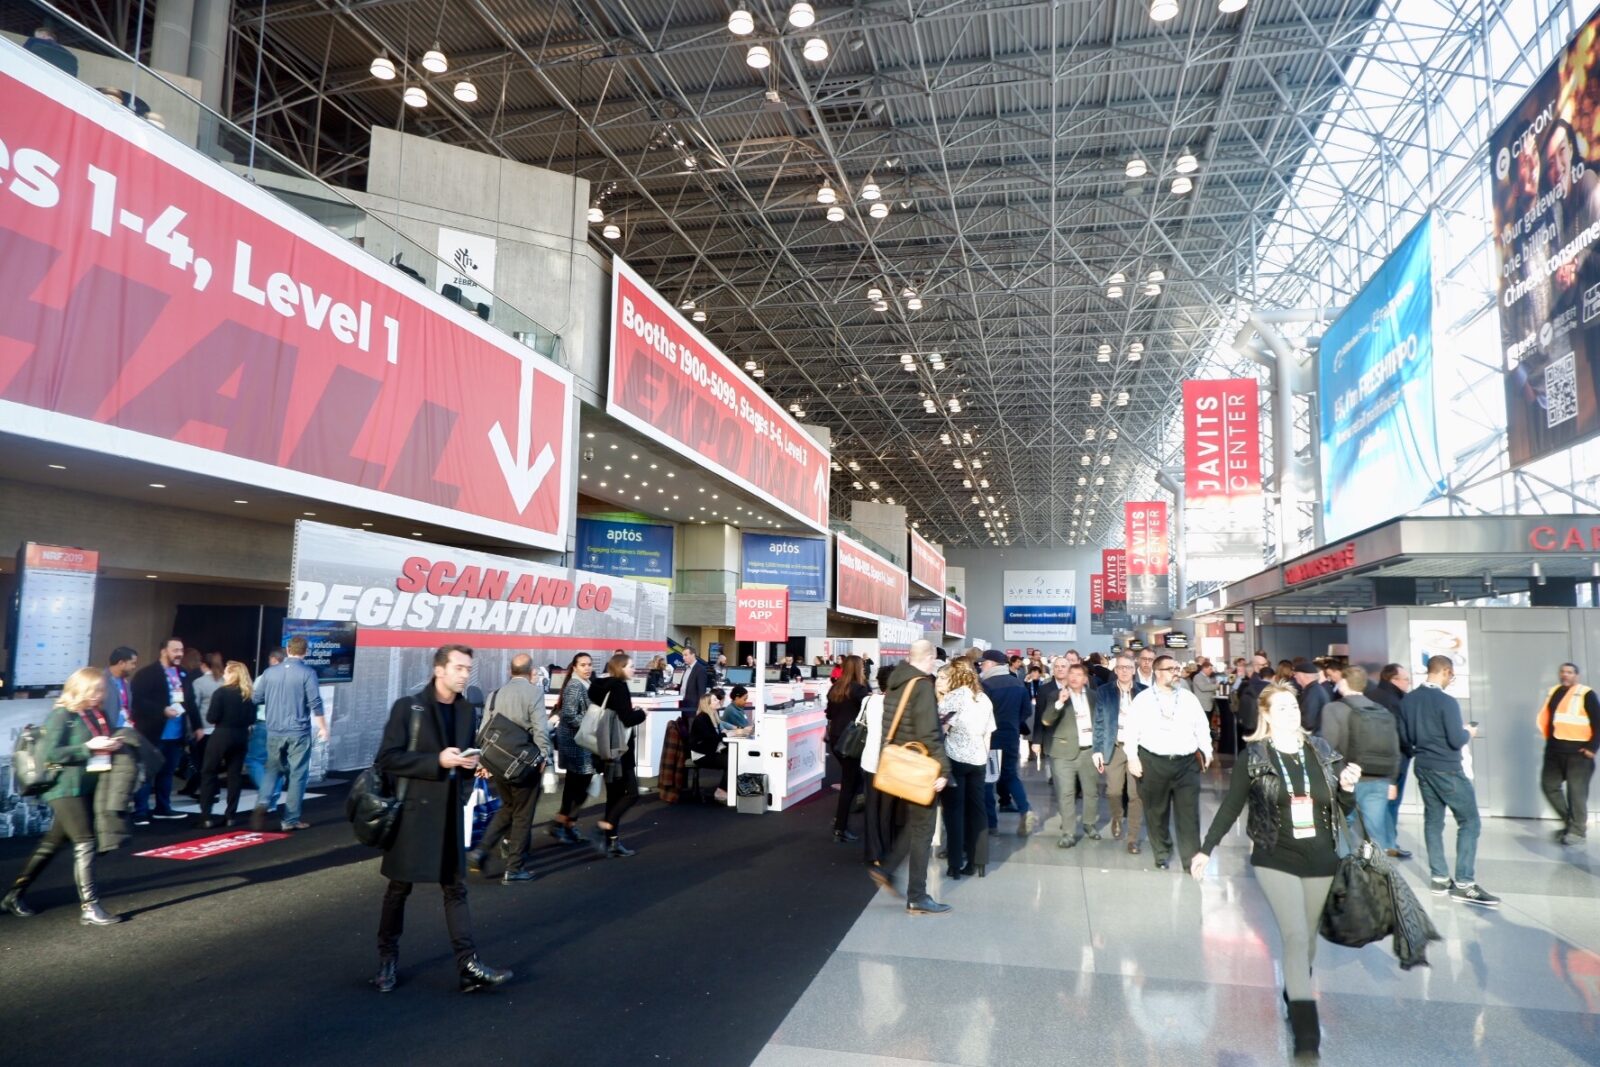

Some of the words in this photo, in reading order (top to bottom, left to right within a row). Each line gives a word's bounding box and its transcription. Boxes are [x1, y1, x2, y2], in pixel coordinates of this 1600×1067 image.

[1512, 103, 1553, 158] CITCON
[1524, 180, 1567, 233] gateway
[1571, 162, 1585, 183] to
[87, 163, 212, 291] 1-4,
[232, 239, 372, 352] Level
[383, 315, 399, 365] 1
[1503, 252, 1521, 277] one
[1522, 221, 1557, 262] billion
[1545, 218, 1600, 276] consume
[453, 276, 478, 288] ZEBRA
[622, 295, 677, 364] Booths
[679, 344, 739, 417] 1900-5099,
[740, 396, 769, 436] Stages
[621, 348, 744, 475] EXPO
[1196, 396, 1222, 491] JAVITS
[1228, 394, 1248, 492] CENTER
[1132, 510, 1146, 566] JAVITS
[1149, 509, 1162, 566] CENTER
[396, 556, 508, 601] SCAN
[508, 574, 576, 608] AND
[577, 582, 614, 613] GO
[1093, 577, 1102, 609] JAVITS
[1107, 555, 1118, 593] JAVITS
[289, 580, 577, 635] REGISTRATION
[738, 599, 784, 609] MOBILE
[748, 611, 773, 620] APP
[312, 649, 333, 659] digital
[313, 640, 341, 649] solutions
